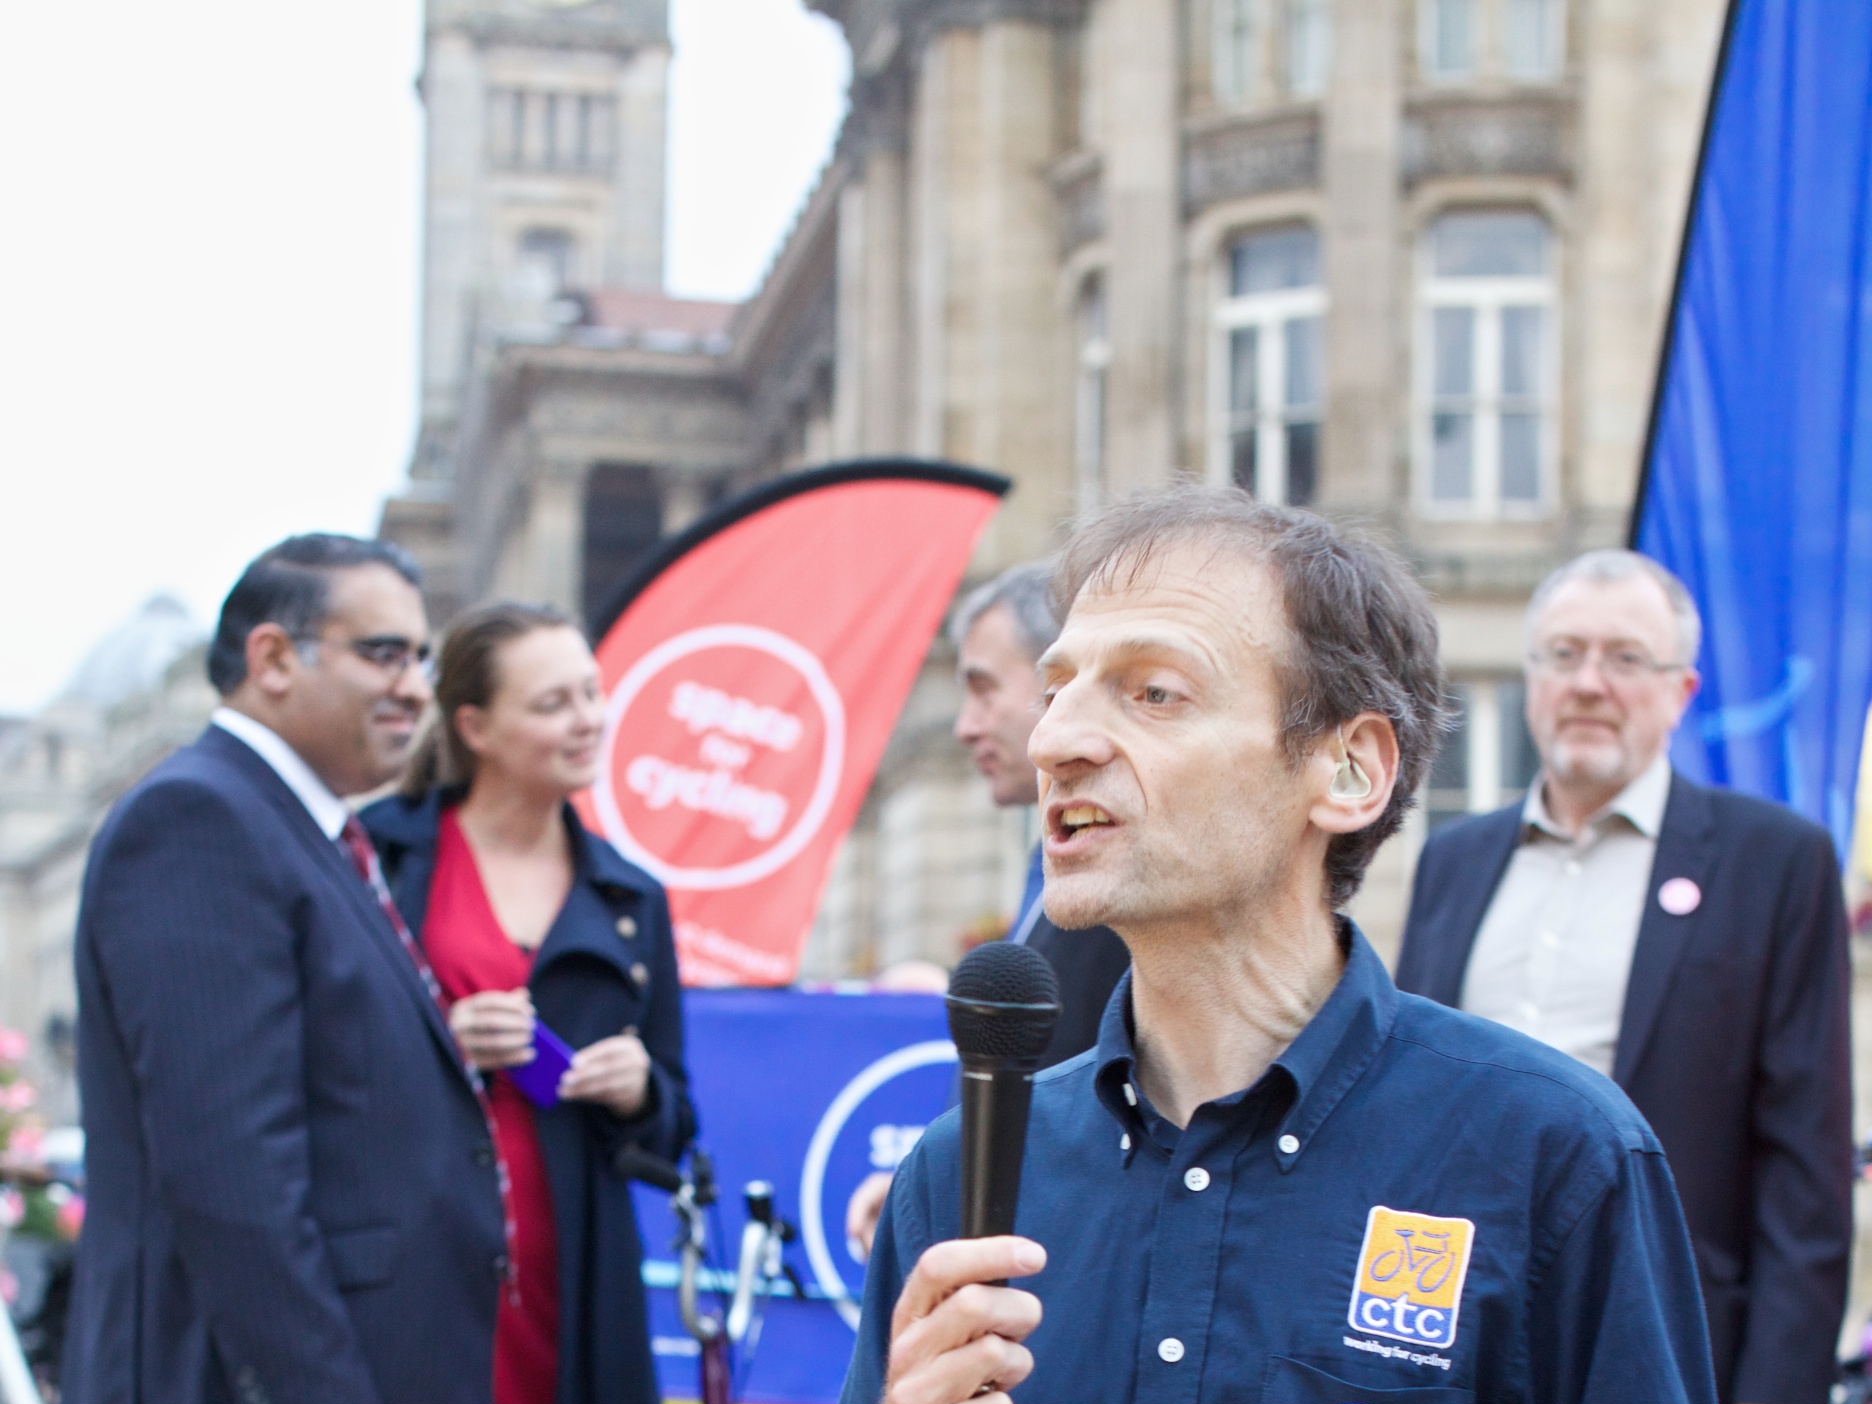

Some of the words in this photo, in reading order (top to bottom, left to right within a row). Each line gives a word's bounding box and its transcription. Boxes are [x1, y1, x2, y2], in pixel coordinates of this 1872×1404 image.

[626, 755, 788, 840] cycling
[1361, 1292, 1445, 1339] ctc
[1343, 1336, 1392, 1358] working
[1391, 1346, 1411, 1360] for
[1410, 1353, 1452, 1371] cycling
